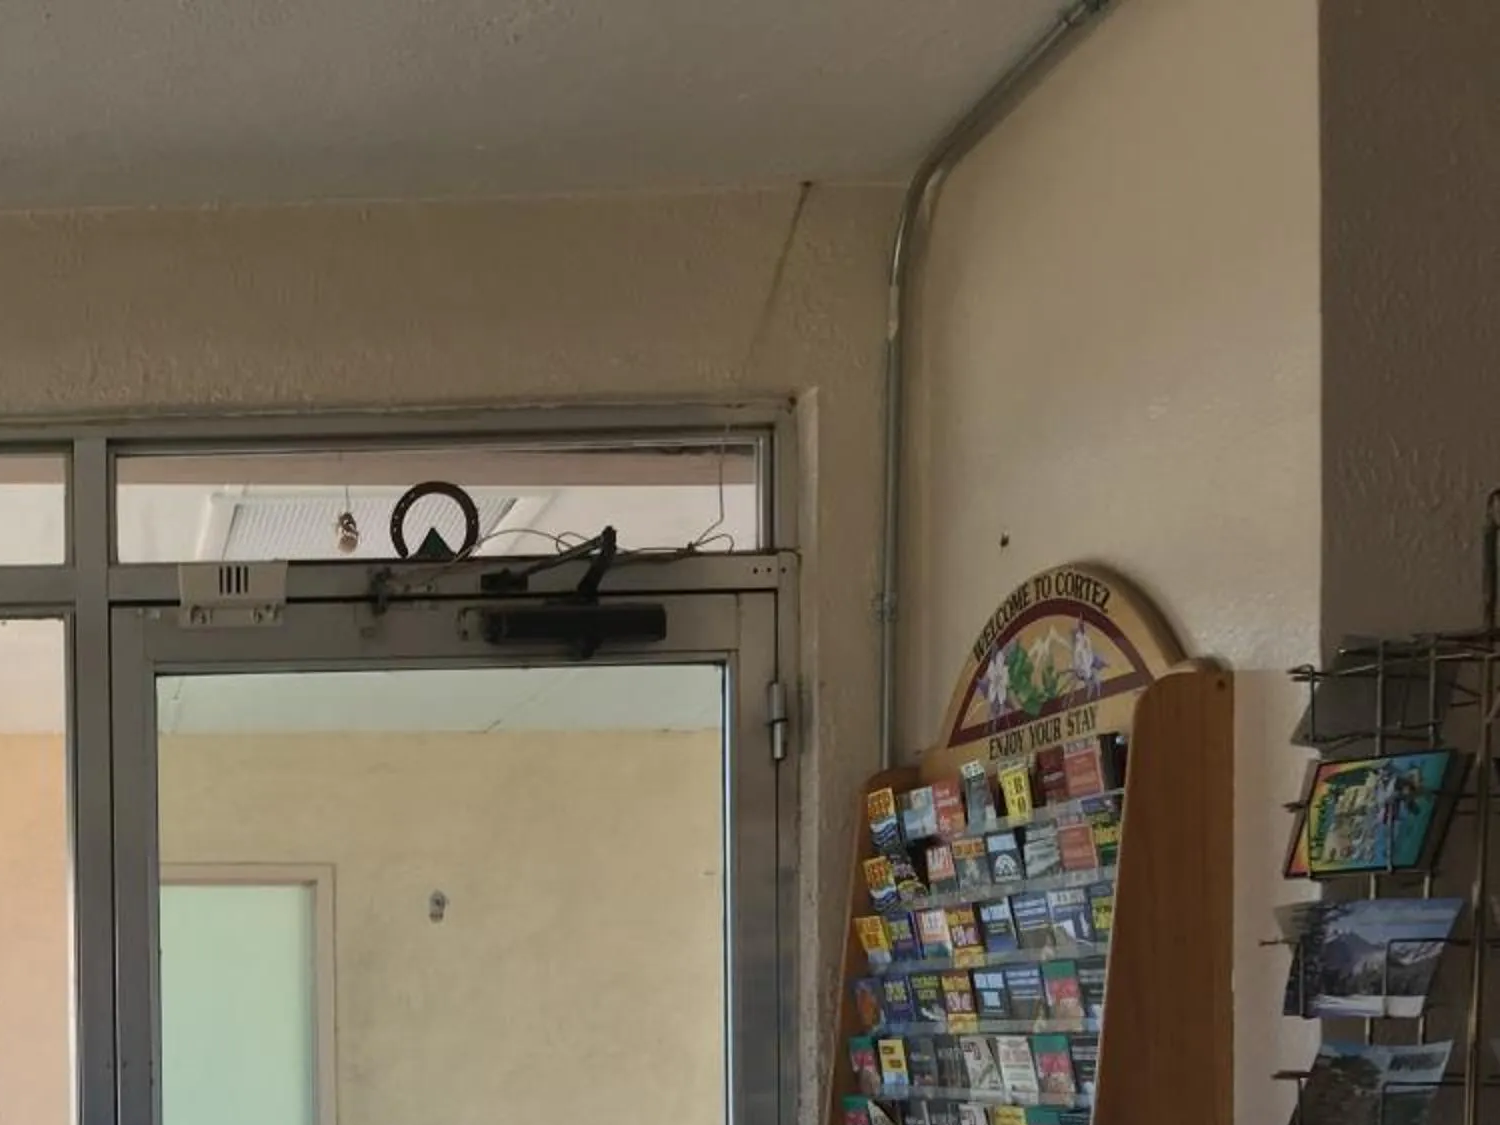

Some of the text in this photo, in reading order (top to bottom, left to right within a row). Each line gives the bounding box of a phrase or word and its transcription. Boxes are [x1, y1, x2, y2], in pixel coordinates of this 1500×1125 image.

[973, 571, 1111, 662] WELCOME TO CORTEZ
[988, 728, 1024, 761] ENJOY
[1029, 717, 1062, 750] YOUR
[1067, 706, 1098, 737] STAY
